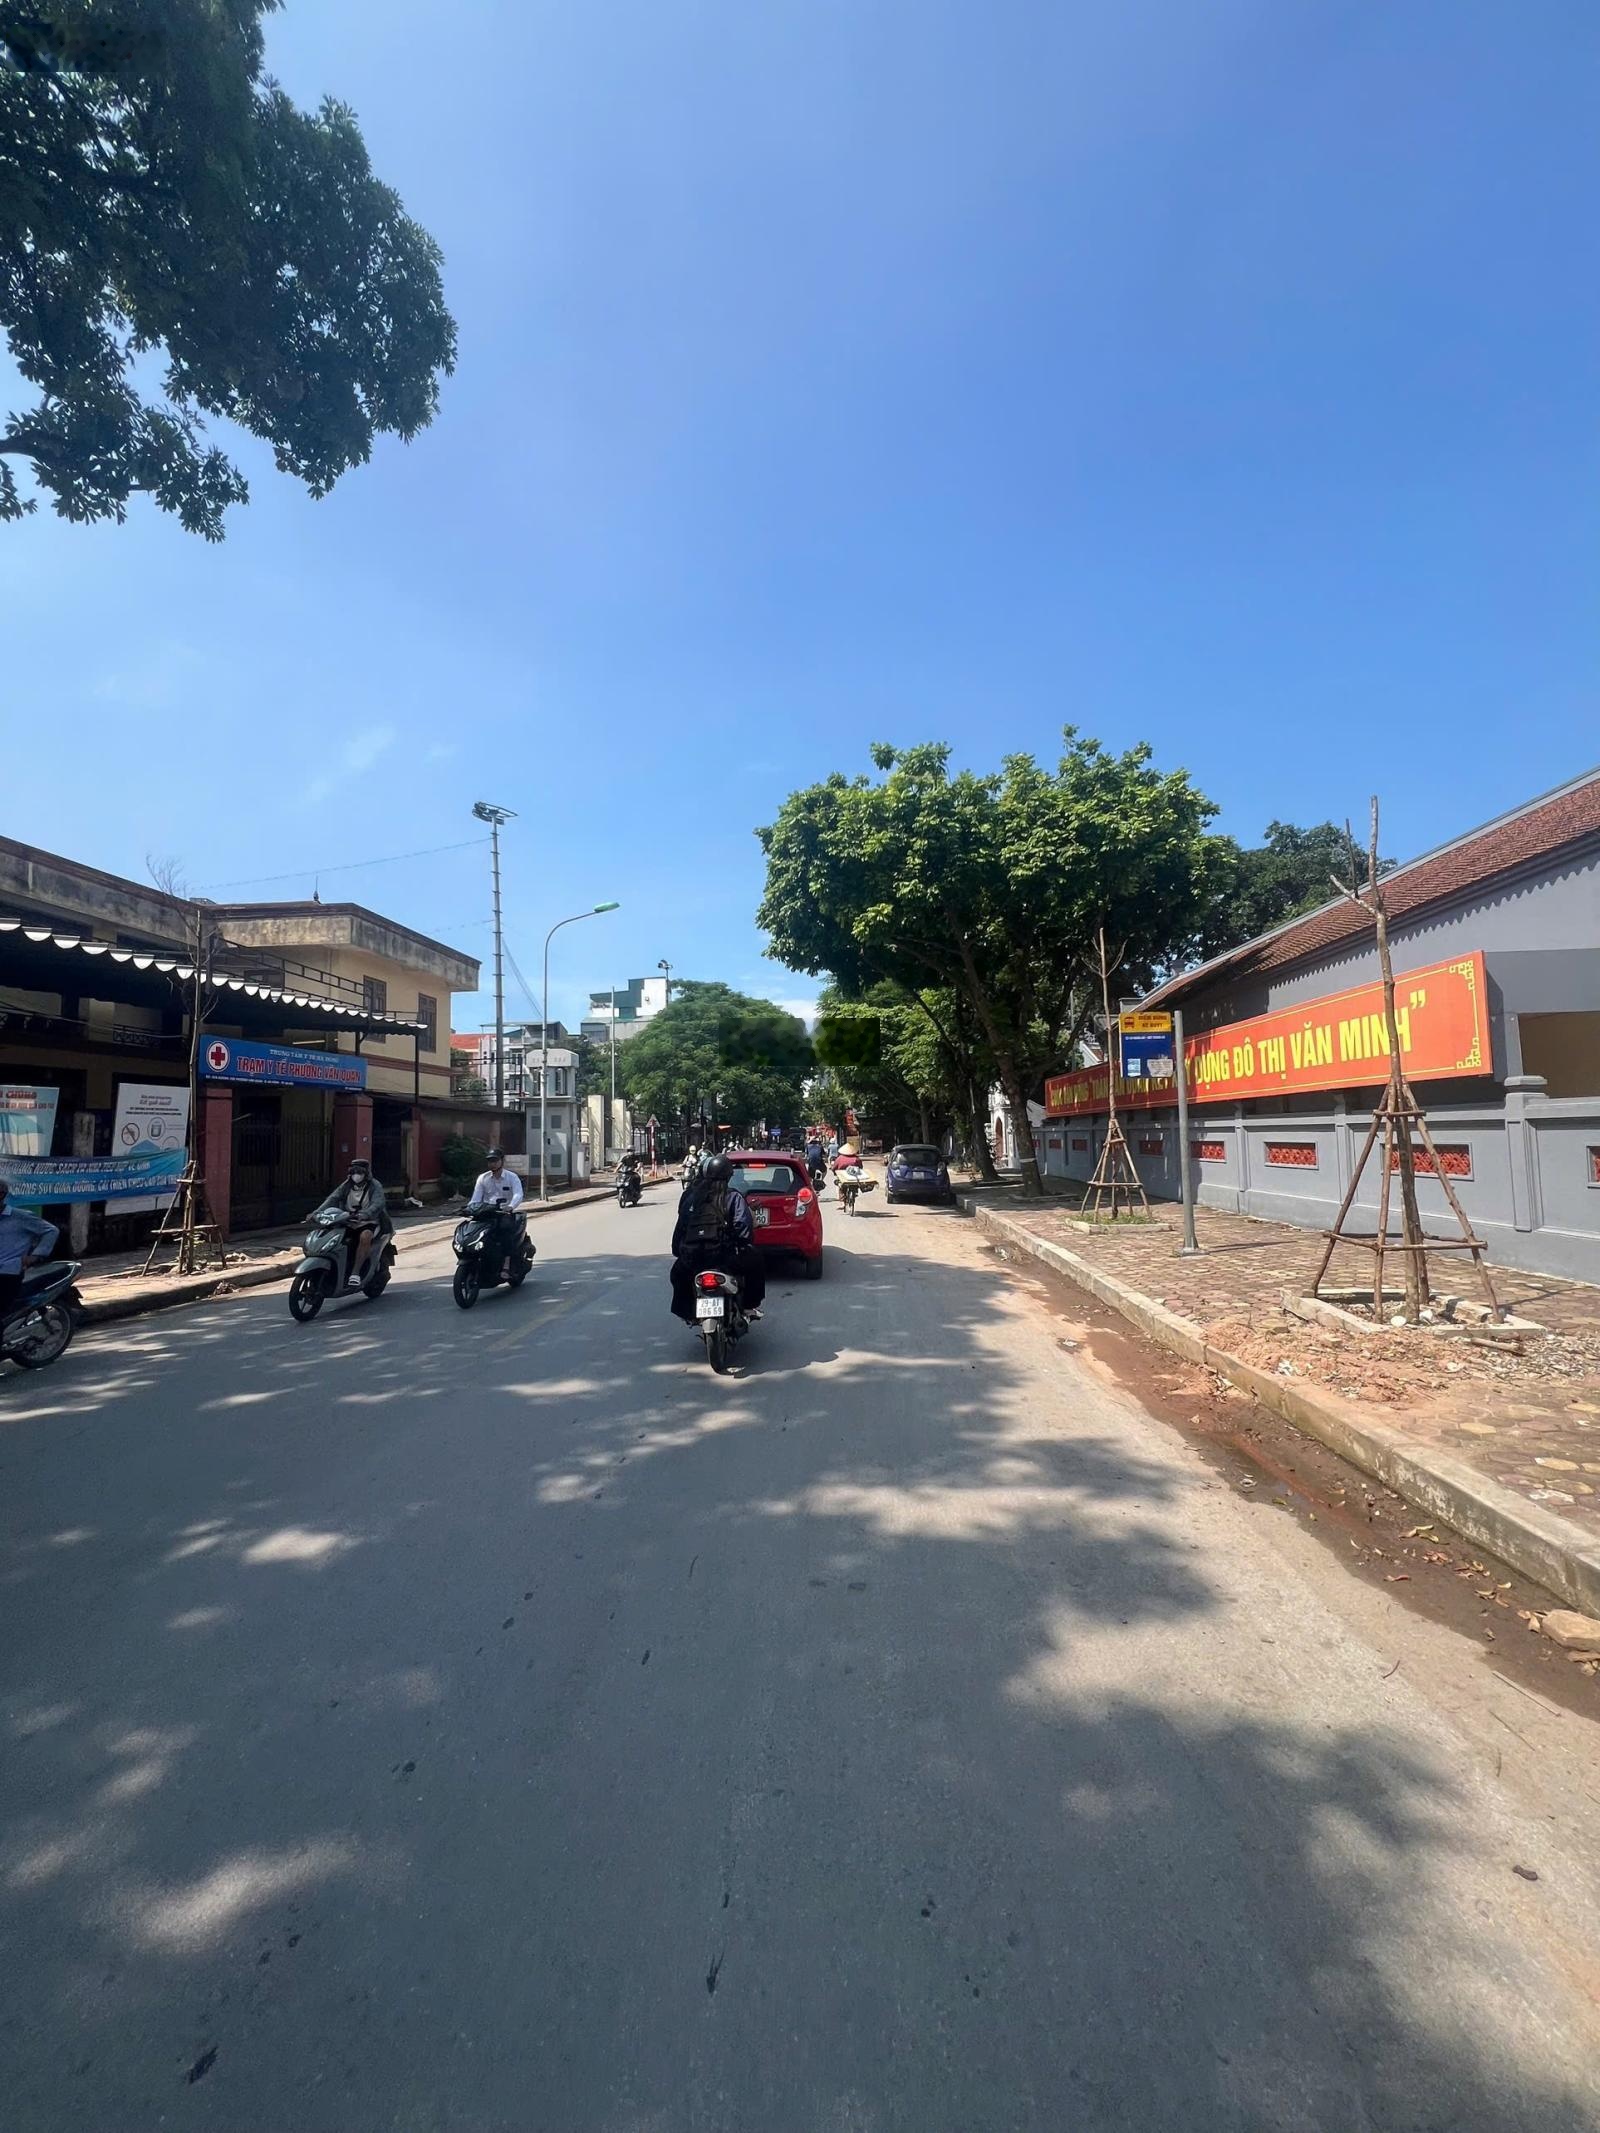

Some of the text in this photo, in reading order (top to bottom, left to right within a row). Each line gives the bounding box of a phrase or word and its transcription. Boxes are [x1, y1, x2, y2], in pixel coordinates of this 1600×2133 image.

[237, 1056, 265, 1076] TRẠM
[267, 1059, 274, 1075] Y
[276, 1058, 287, 1076] TẾ
[288, 1060, 322, 1080] PHƯỜNG
[1195, 1047, 1230, 1090] DỰNG
[1233, 1037, 1255, 1078] ĐÔ
[1257, 1036, 1287, 1080] THỊ
[1290, 1021, 1333, 1069] VĂN
